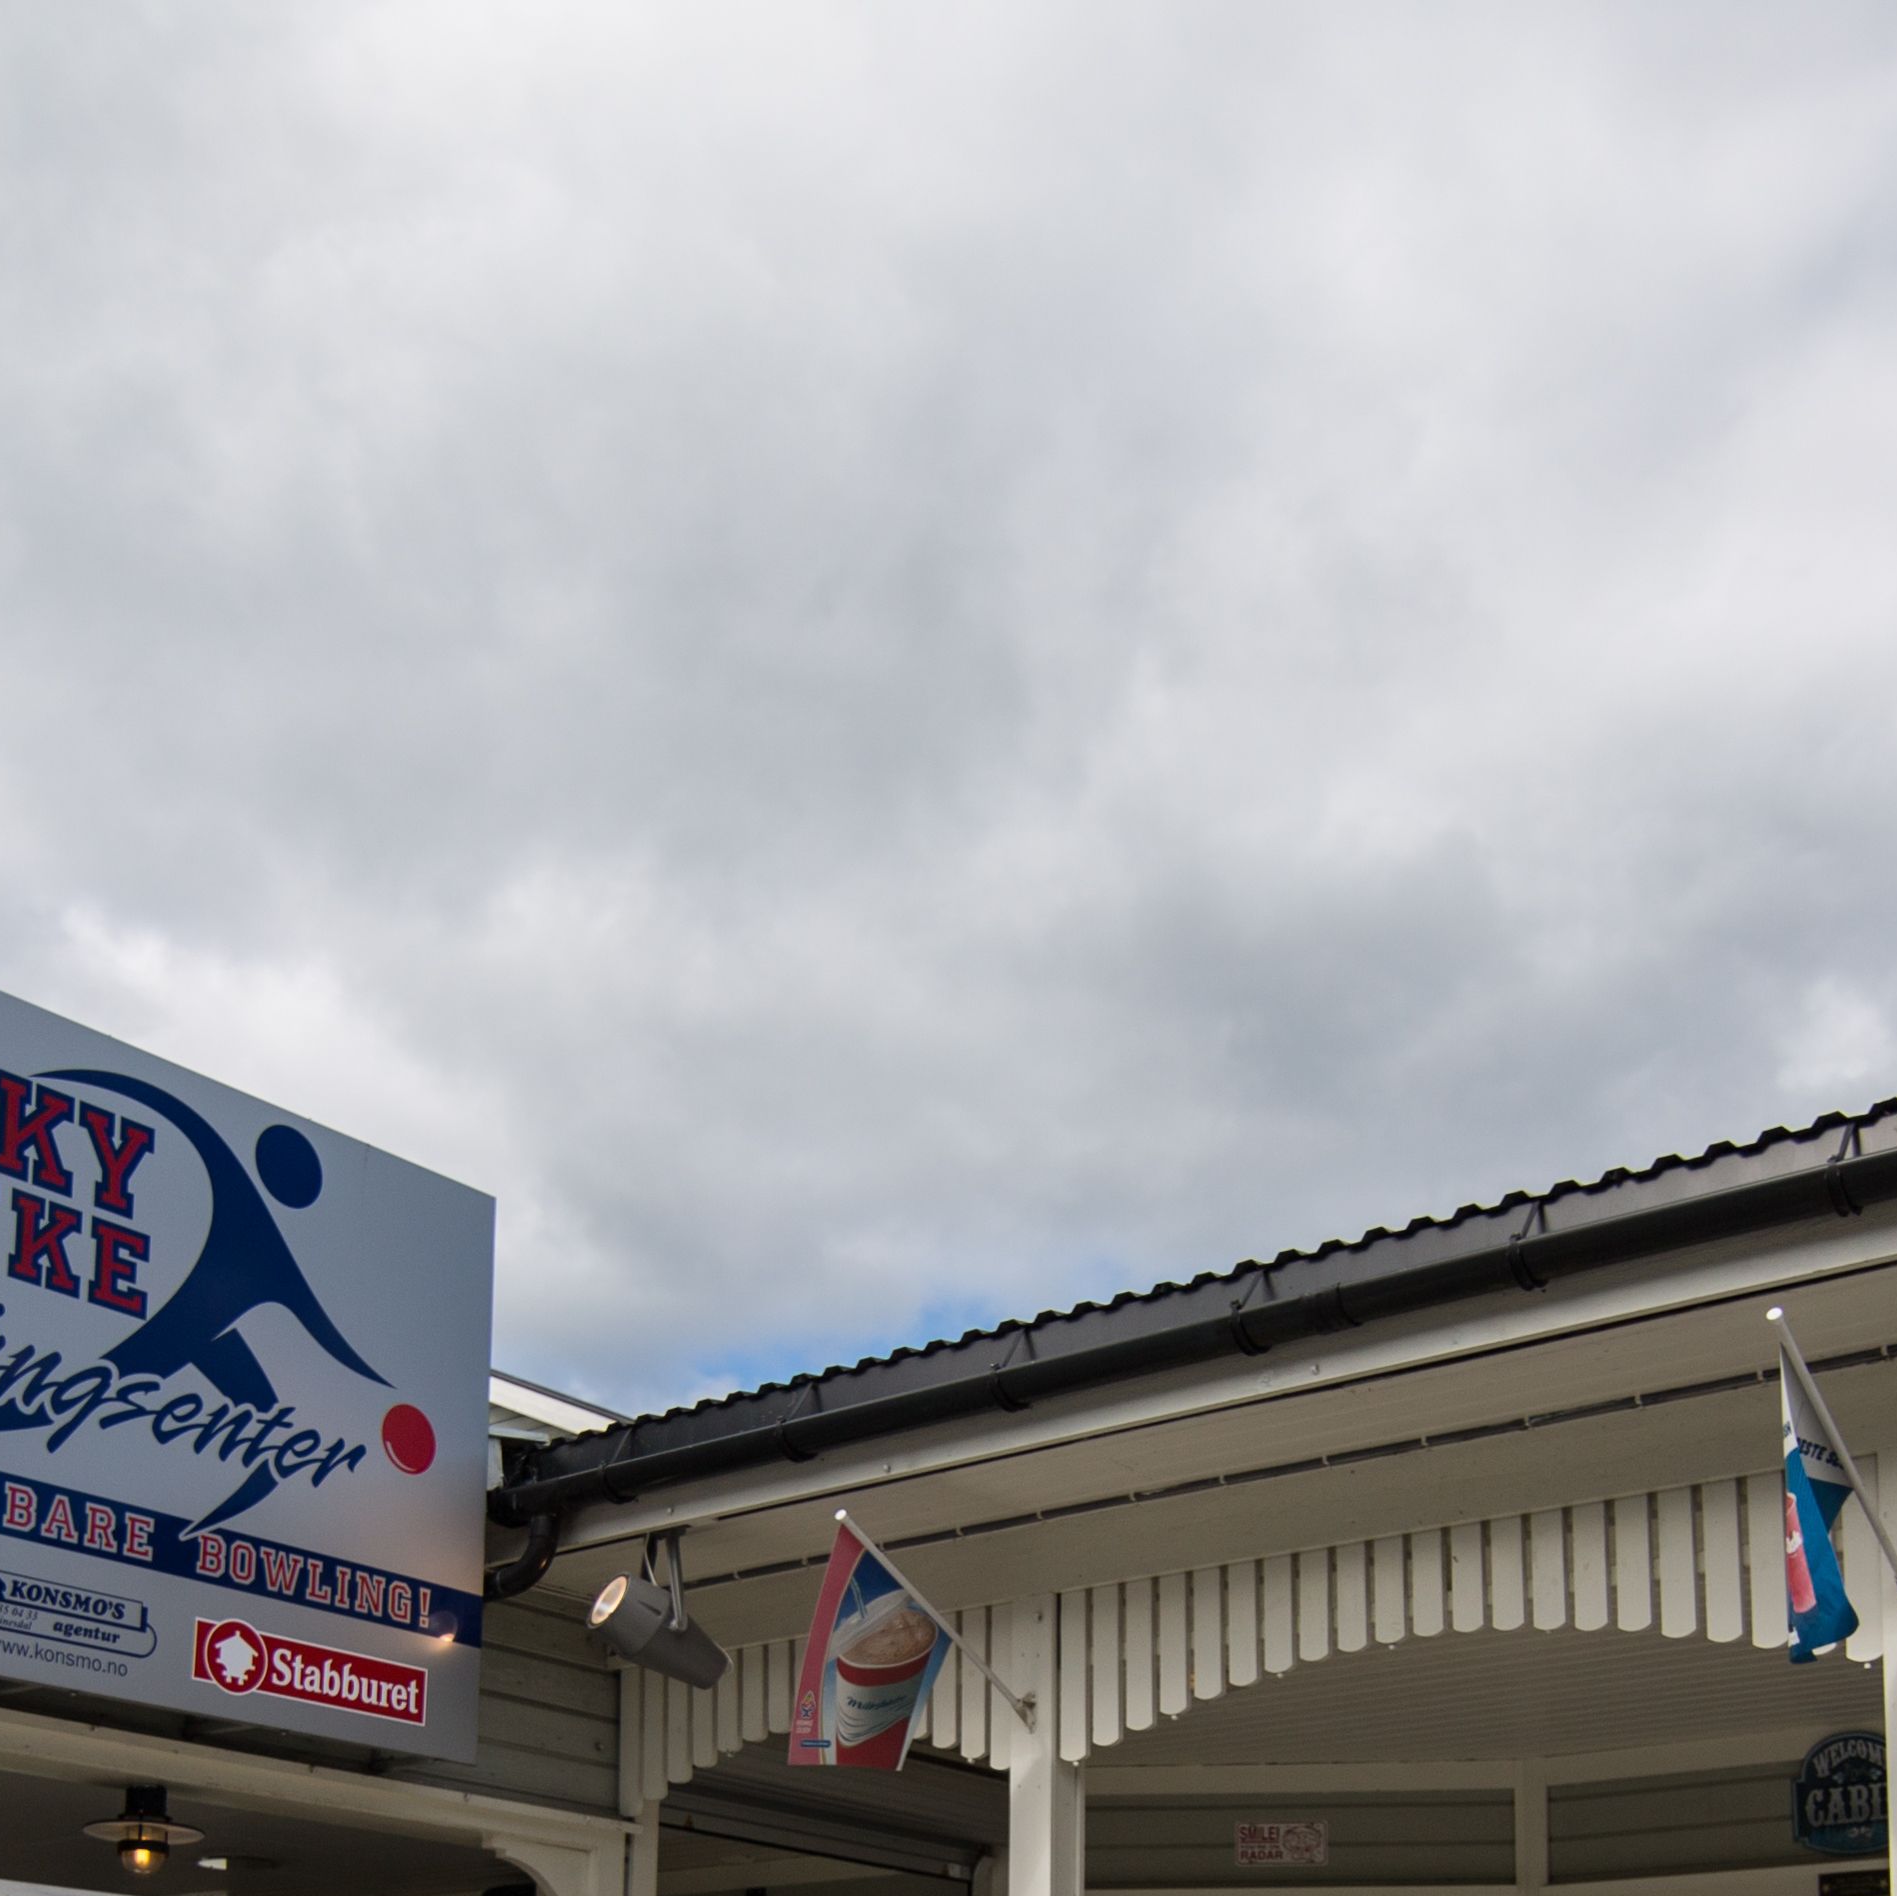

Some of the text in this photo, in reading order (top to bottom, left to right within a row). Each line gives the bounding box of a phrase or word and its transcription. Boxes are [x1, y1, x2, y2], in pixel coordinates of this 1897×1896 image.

[4, 1483, 154, 1560] BARE
[197, 1532, 433, 1628] BOWLING!
[9, 1579, 126, 1620] KONSMO'S
[53, 1620, 120, 1643] agentur
[271, 1645, 421, 1714] Stabburet
[1812, 1739, 1886, 1778] WELCOM
[1806, 1783, 1888, 1827] CABI
[1240, 1850, 1283, 1860] RADAR
